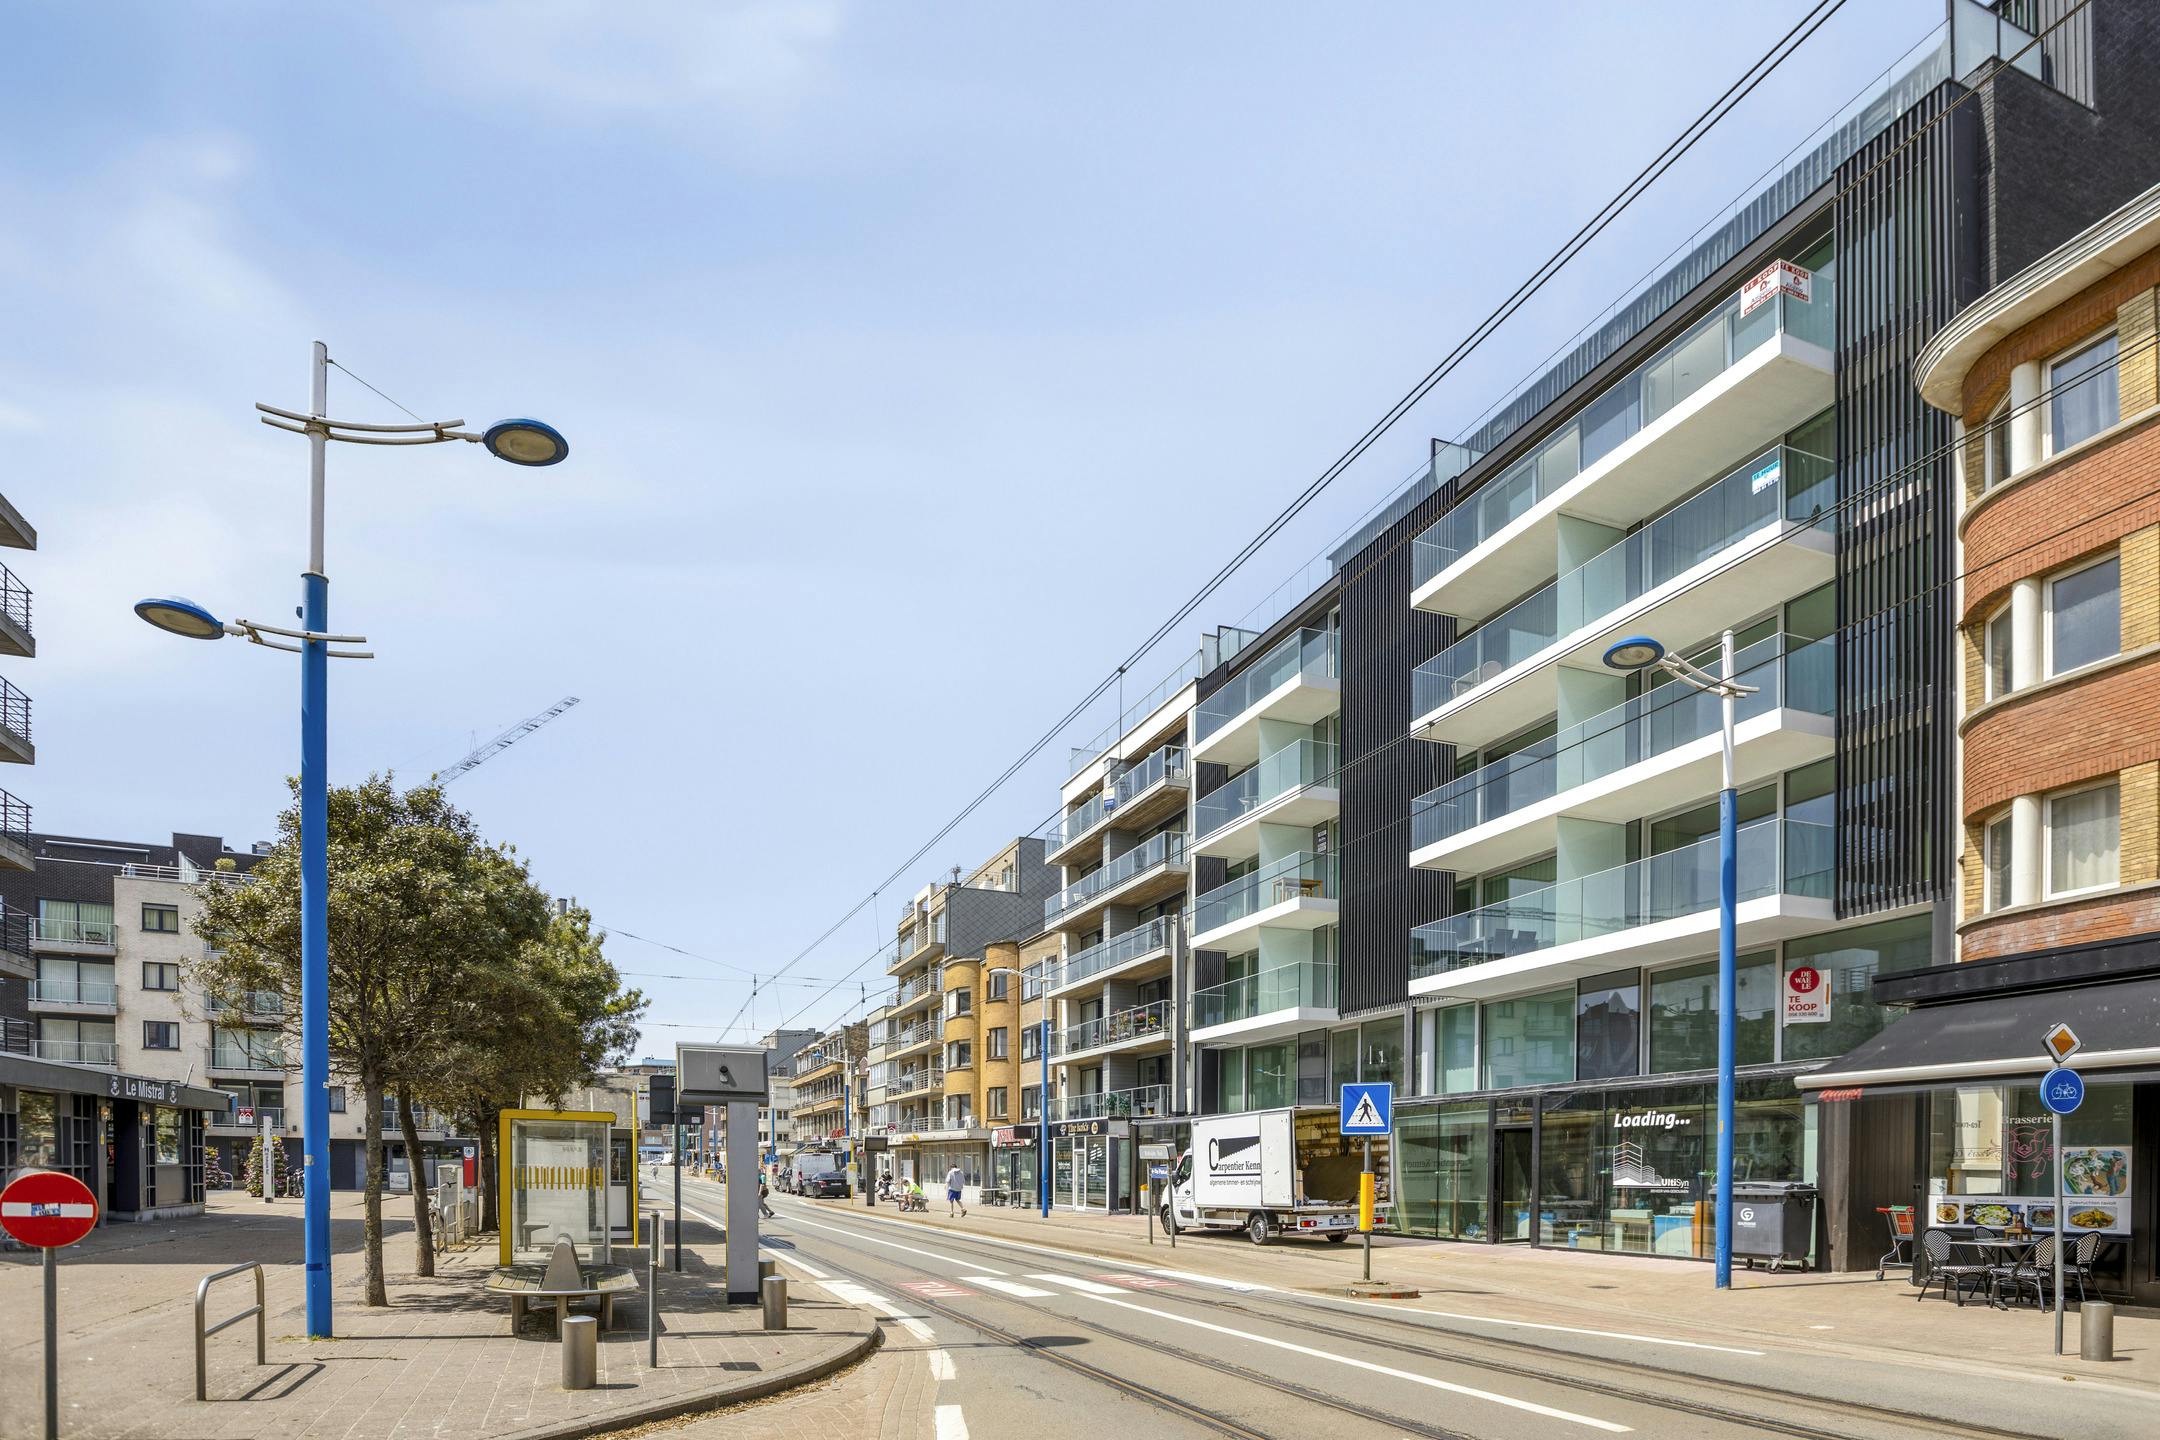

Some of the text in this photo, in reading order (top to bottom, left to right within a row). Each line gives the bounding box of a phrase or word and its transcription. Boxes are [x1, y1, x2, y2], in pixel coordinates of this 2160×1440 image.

[1788, 995, 1801, 1003] TE
[1788, 1003, 1817, 1011] KOOP
[125, 1079, 165, 1100] Le Mistral
[1614, 1110, 1691, 1129] Loading...
[1208, 1137, 1244, 1174] Carpentier
[1661, 1178, 1690, 1188] UltiSyn
